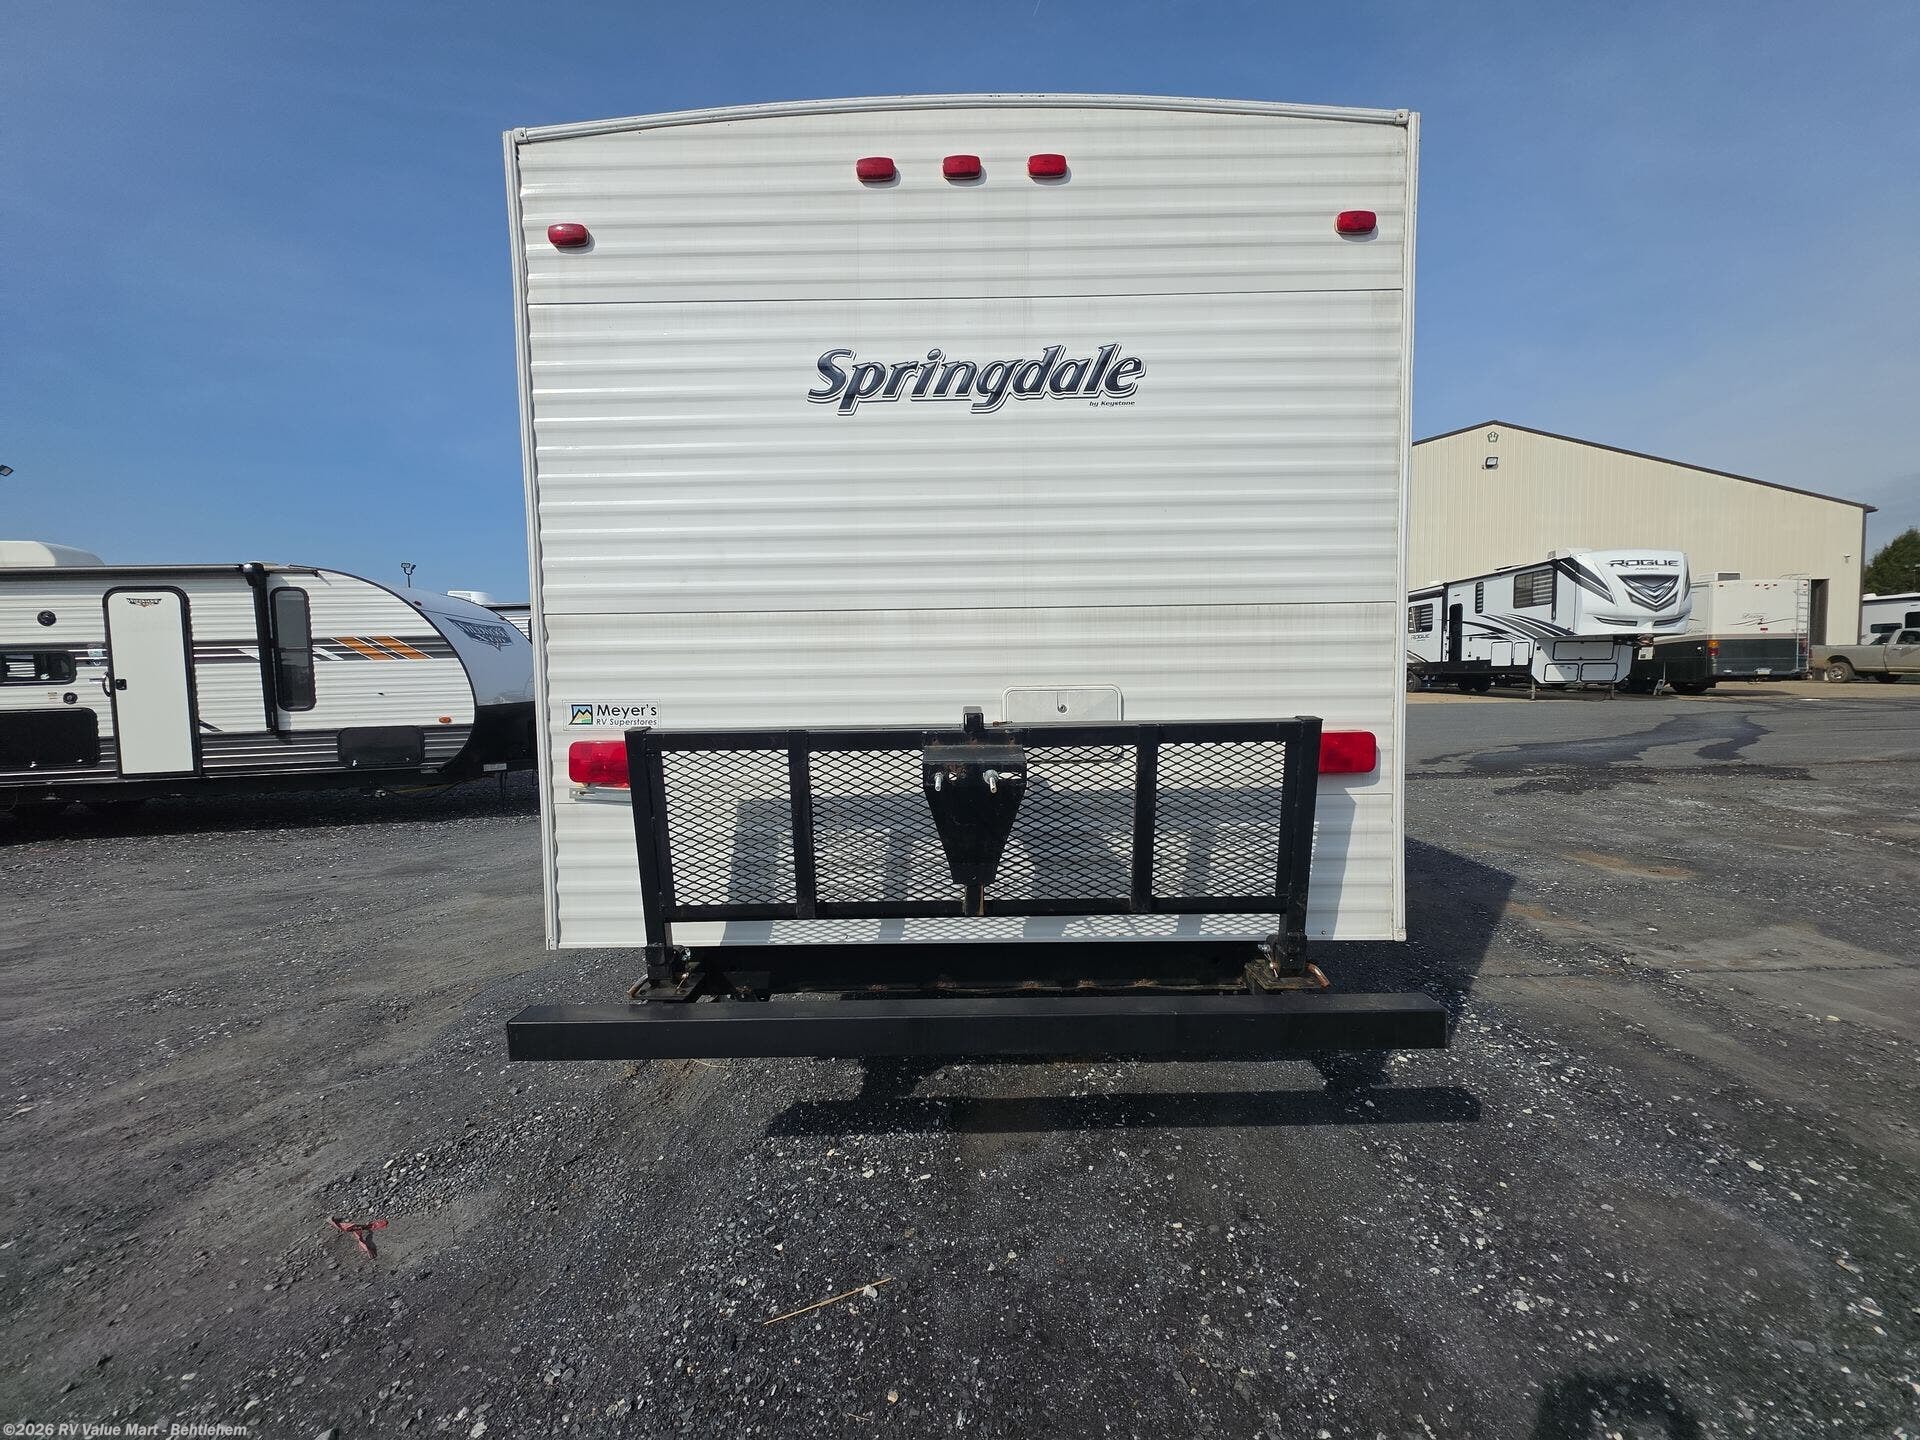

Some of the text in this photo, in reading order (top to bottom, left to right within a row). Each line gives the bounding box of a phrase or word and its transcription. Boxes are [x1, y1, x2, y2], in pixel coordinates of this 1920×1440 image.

[807, 343, 1146, 416] Springdale
[1607, 559, 1680, 567] ROGUE
[597, 704, 657, 719] Meyer's
[610, 718, 657, 726] Superstores
